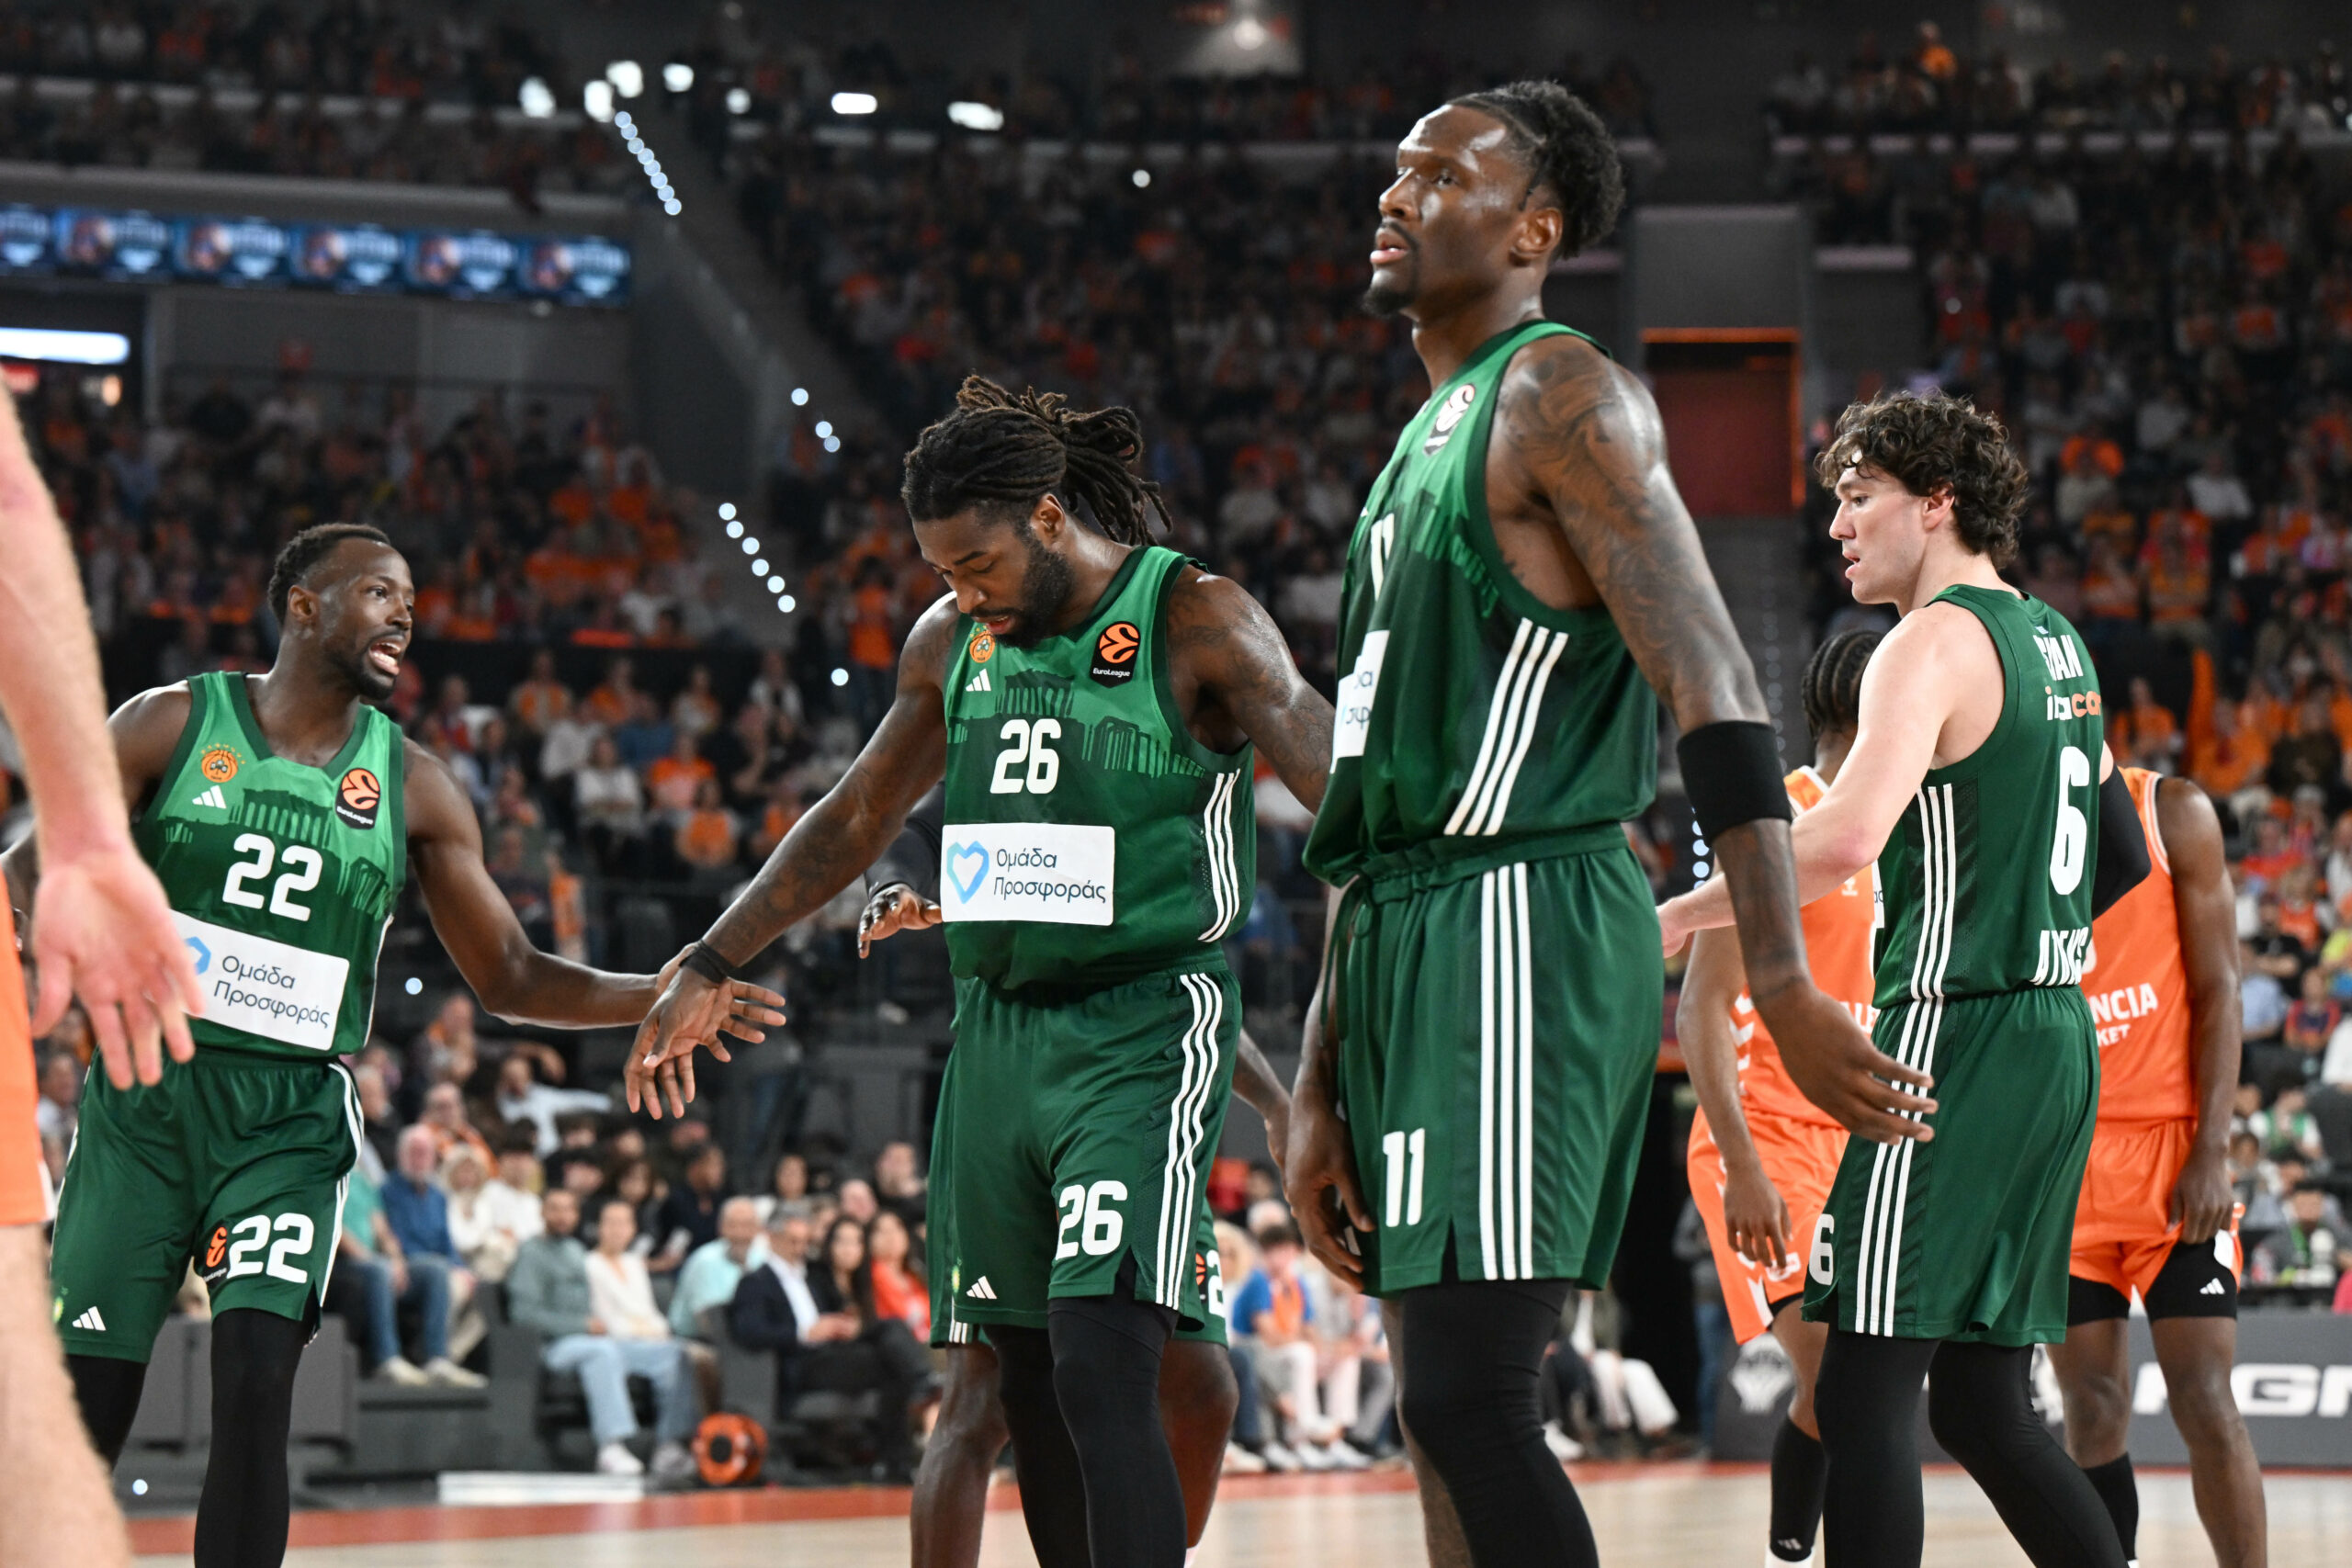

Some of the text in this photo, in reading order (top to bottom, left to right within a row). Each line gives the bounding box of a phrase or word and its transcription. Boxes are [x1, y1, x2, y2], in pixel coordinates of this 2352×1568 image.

[1092, 667, 1131, 678] EuroLeague
[989, 718, 1061, 794] 26
[2050, 746, 2090, 896] 6
[222, 833, 323, 922] 22
[996, 847, 1057, 870] Ομάδα
[994, 876, 1106, 904] Προσφοράς
[221, 954, 296, 990] Ομάδα
[213, 978, 331, 1030] Προσφοράς
[2088, 983, 2158, 1024] NCIA
[2096, 1023, 2131, 1047] KET
[1383, 1128, 1425, 1227] 11
[227, 1213, 314, 1283] 22
[1056, 1180, 1128, 1260] 26
[1808, 1213, 1835, 1286] 6
